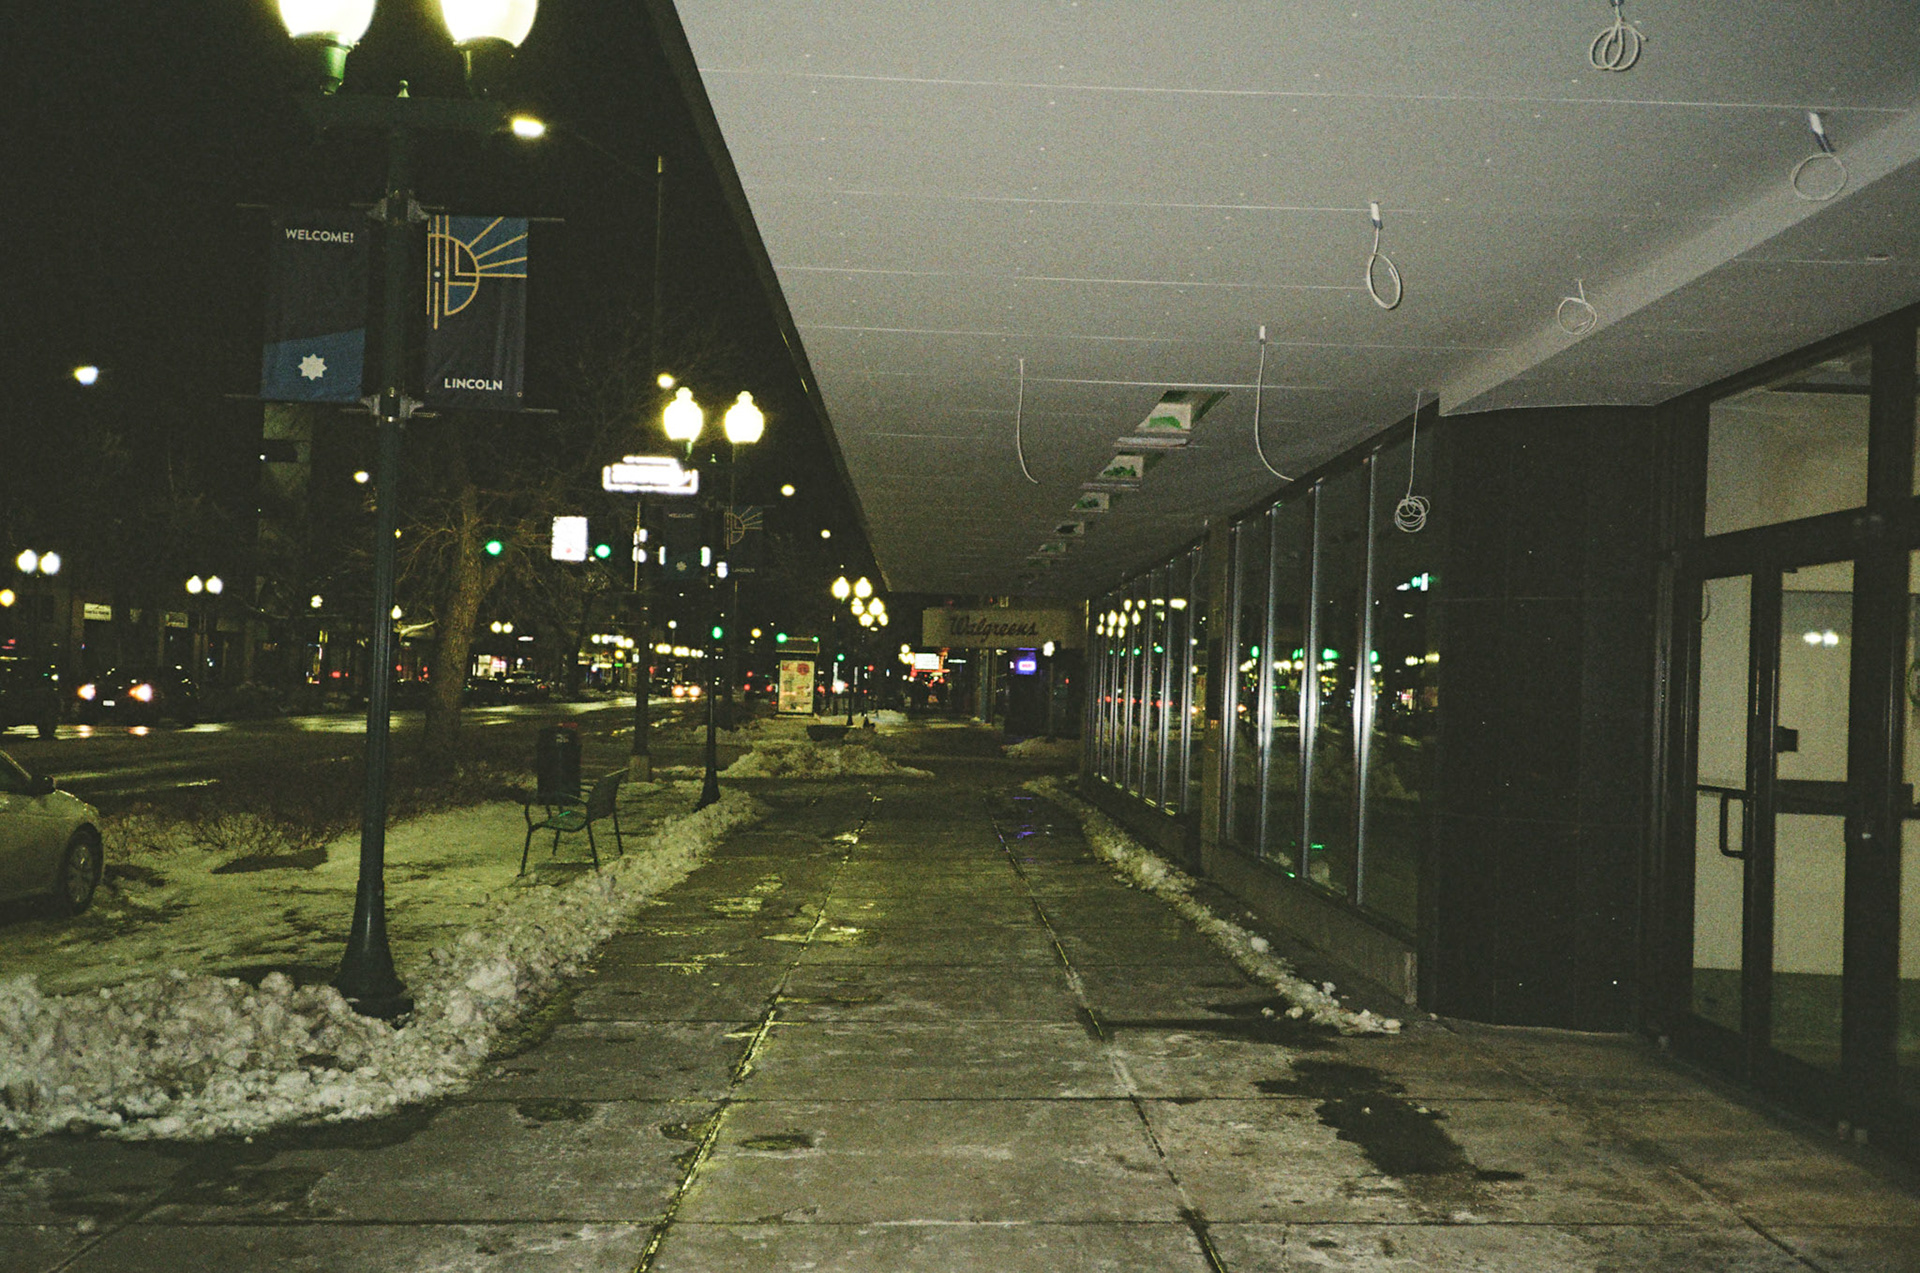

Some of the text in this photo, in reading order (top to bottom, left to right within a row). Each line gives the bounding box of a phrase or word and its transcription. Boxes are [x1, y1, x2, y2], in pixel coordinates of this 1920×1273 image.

[285, 228, 354, 243] WELCOME!
[444, 378, 503, 391] LINCOLN
[950, 614, 1038, 643] Walgreens
